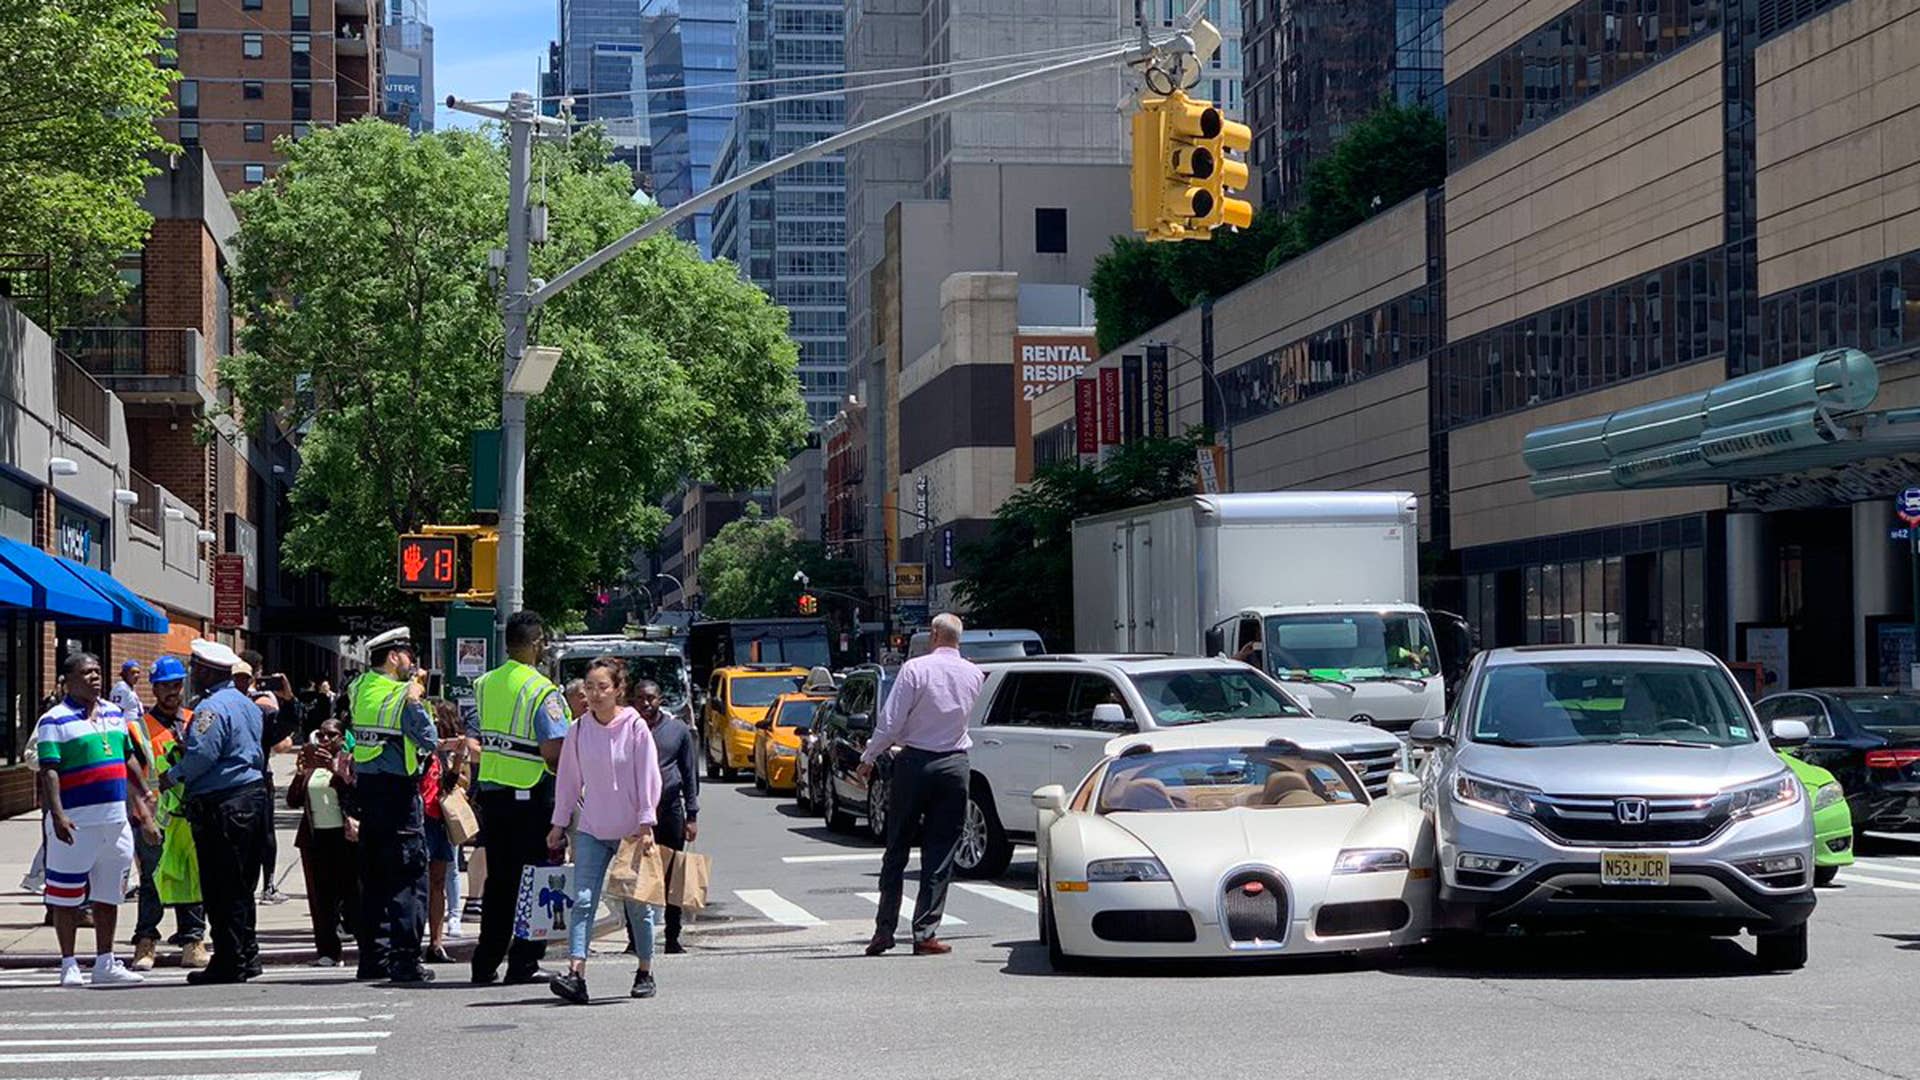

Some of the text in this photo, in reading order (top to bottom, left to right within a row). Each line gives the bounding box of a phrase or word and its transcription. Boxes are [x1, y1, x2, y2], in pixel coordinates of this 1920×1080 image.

[1022, 345, 1092, 362] RENTAL
[1755, 427, 1793, 448] CENTER
[917, 494, 927, 530] STAGE
[434, 549, 453, 582] 13
[1605, 859, 1664, 877] N53 JCR
